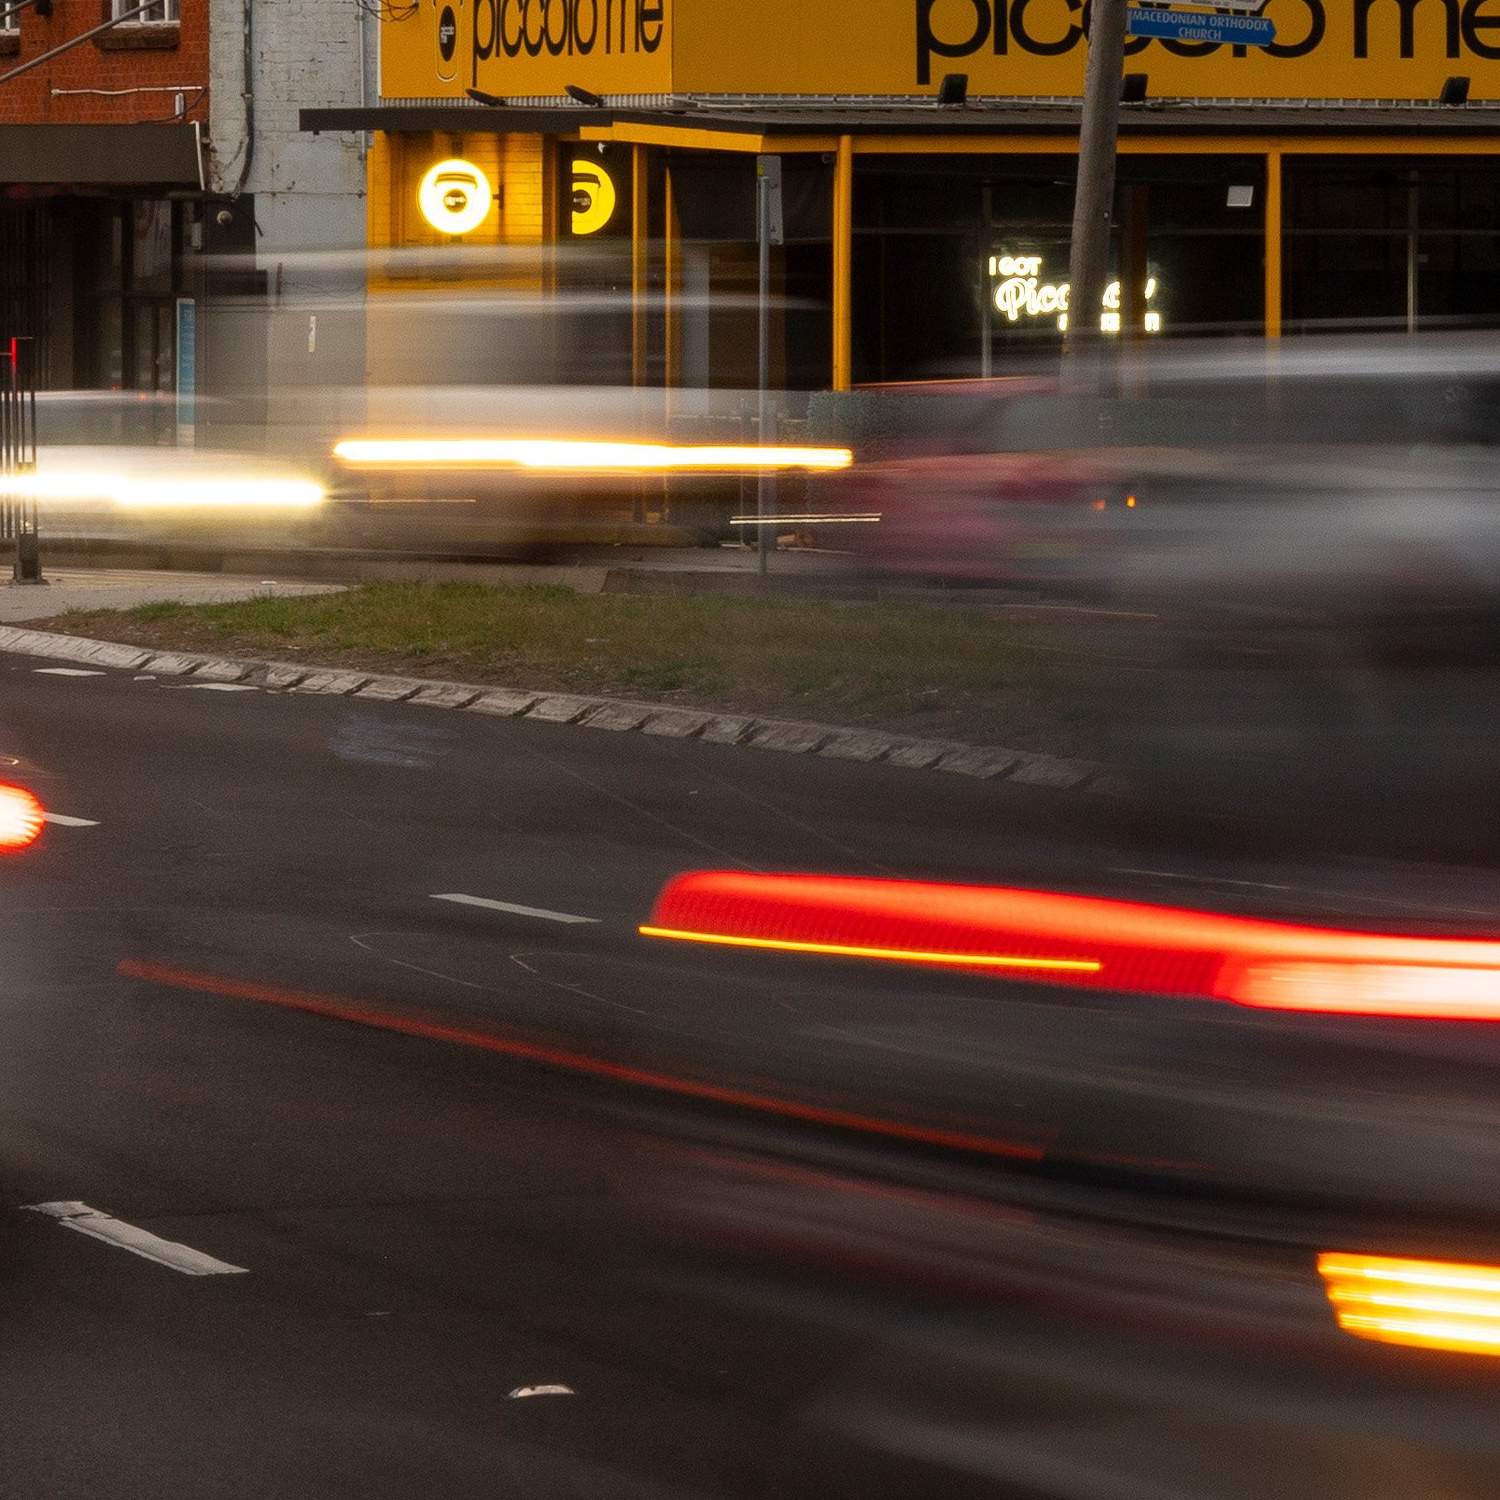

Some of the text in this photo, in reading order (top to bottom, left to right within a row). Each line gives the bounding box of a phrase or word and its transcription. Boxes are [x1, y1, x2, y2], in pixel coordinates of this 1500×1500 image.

[1132, 9, 1269, 31] MACEDONIAN ORTHODOX
[1178, 26, 1223, 41] CHURCH
[998, 256, 1043, 276] GOT
